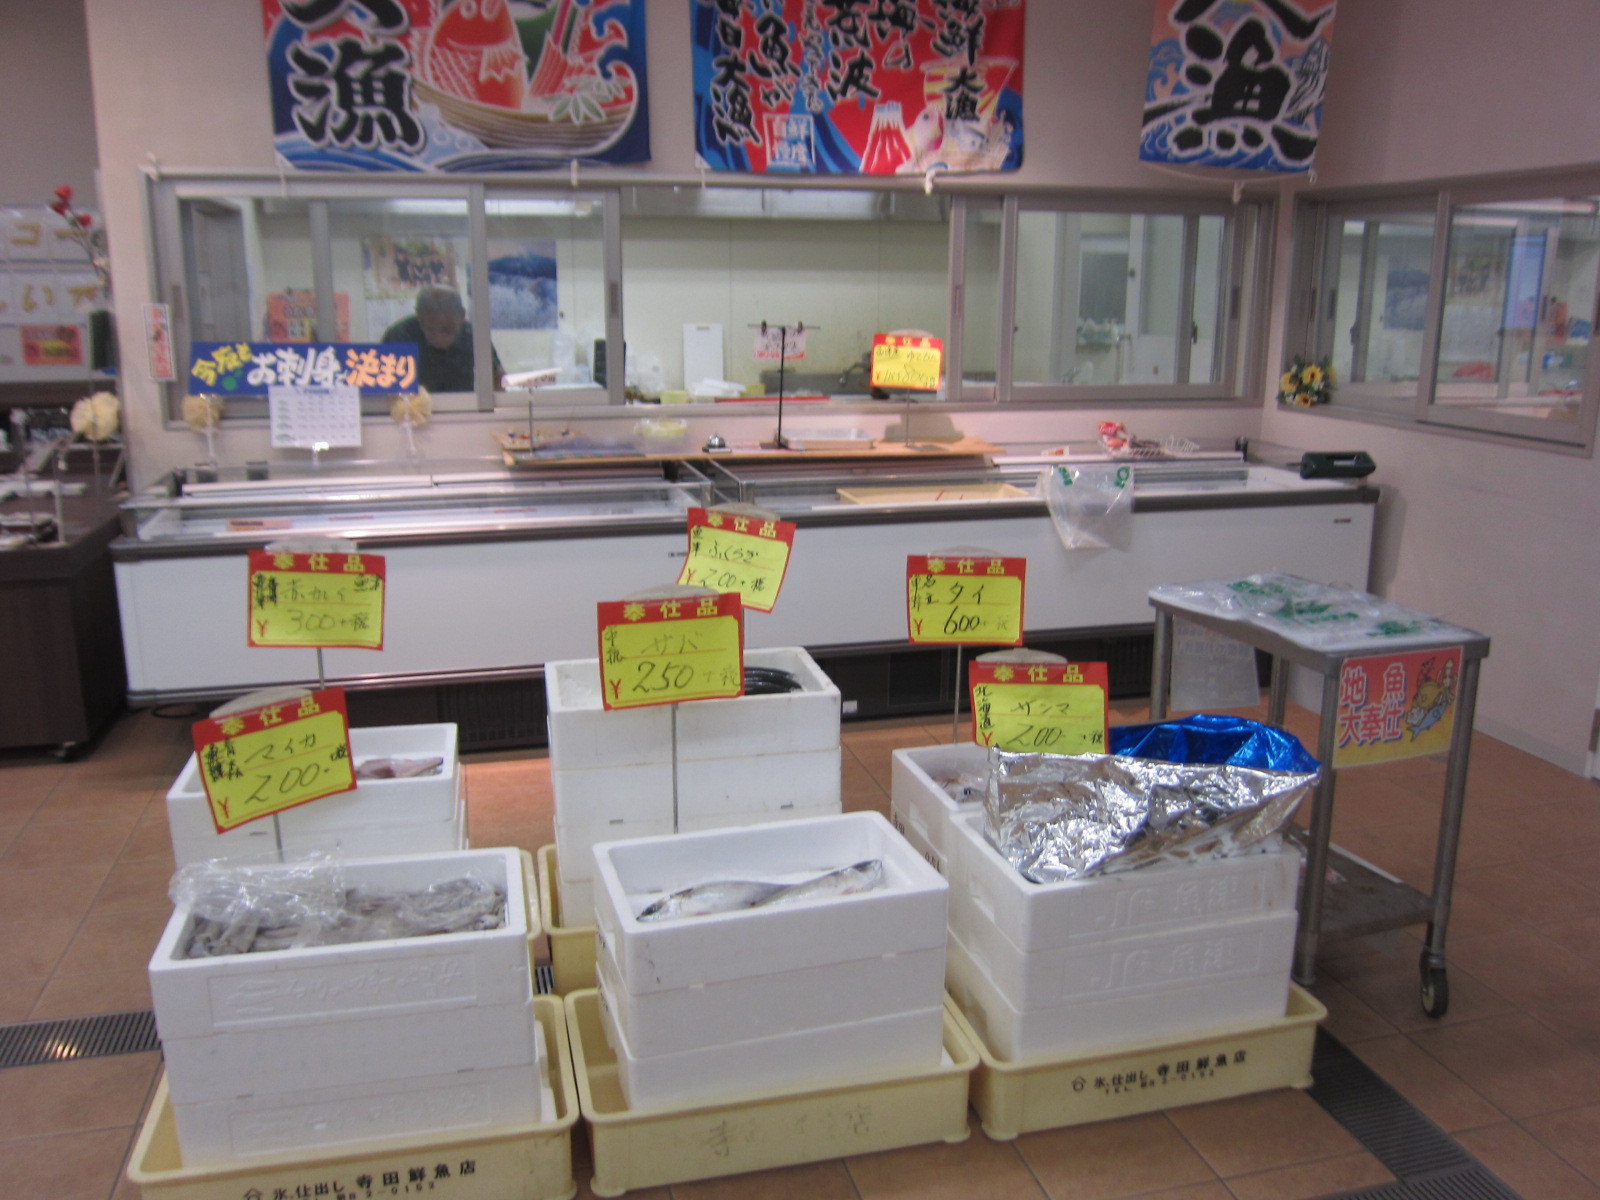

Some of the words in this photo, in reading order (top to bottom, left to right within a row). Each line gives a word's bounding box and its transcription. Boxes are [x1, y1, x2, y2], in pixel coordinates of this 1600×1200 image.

[707, 512, 777, 539] 奉仕品
[273, 552, 366, 573] 奉仕品
[926, 557, 1006, 575] 奉仕品
[623, 597, 719, 622] 奉仕品
[942, 604, 981, 636] 600
[631, 660, 695, 694] 250
[993, 664, 1085, 683] 奉仕品
[1340, 662, 1408, 709] 地魚
[220, 694, 321, 737] 奉仕品
[1337, 702, 1406, 749] 大奉仕
